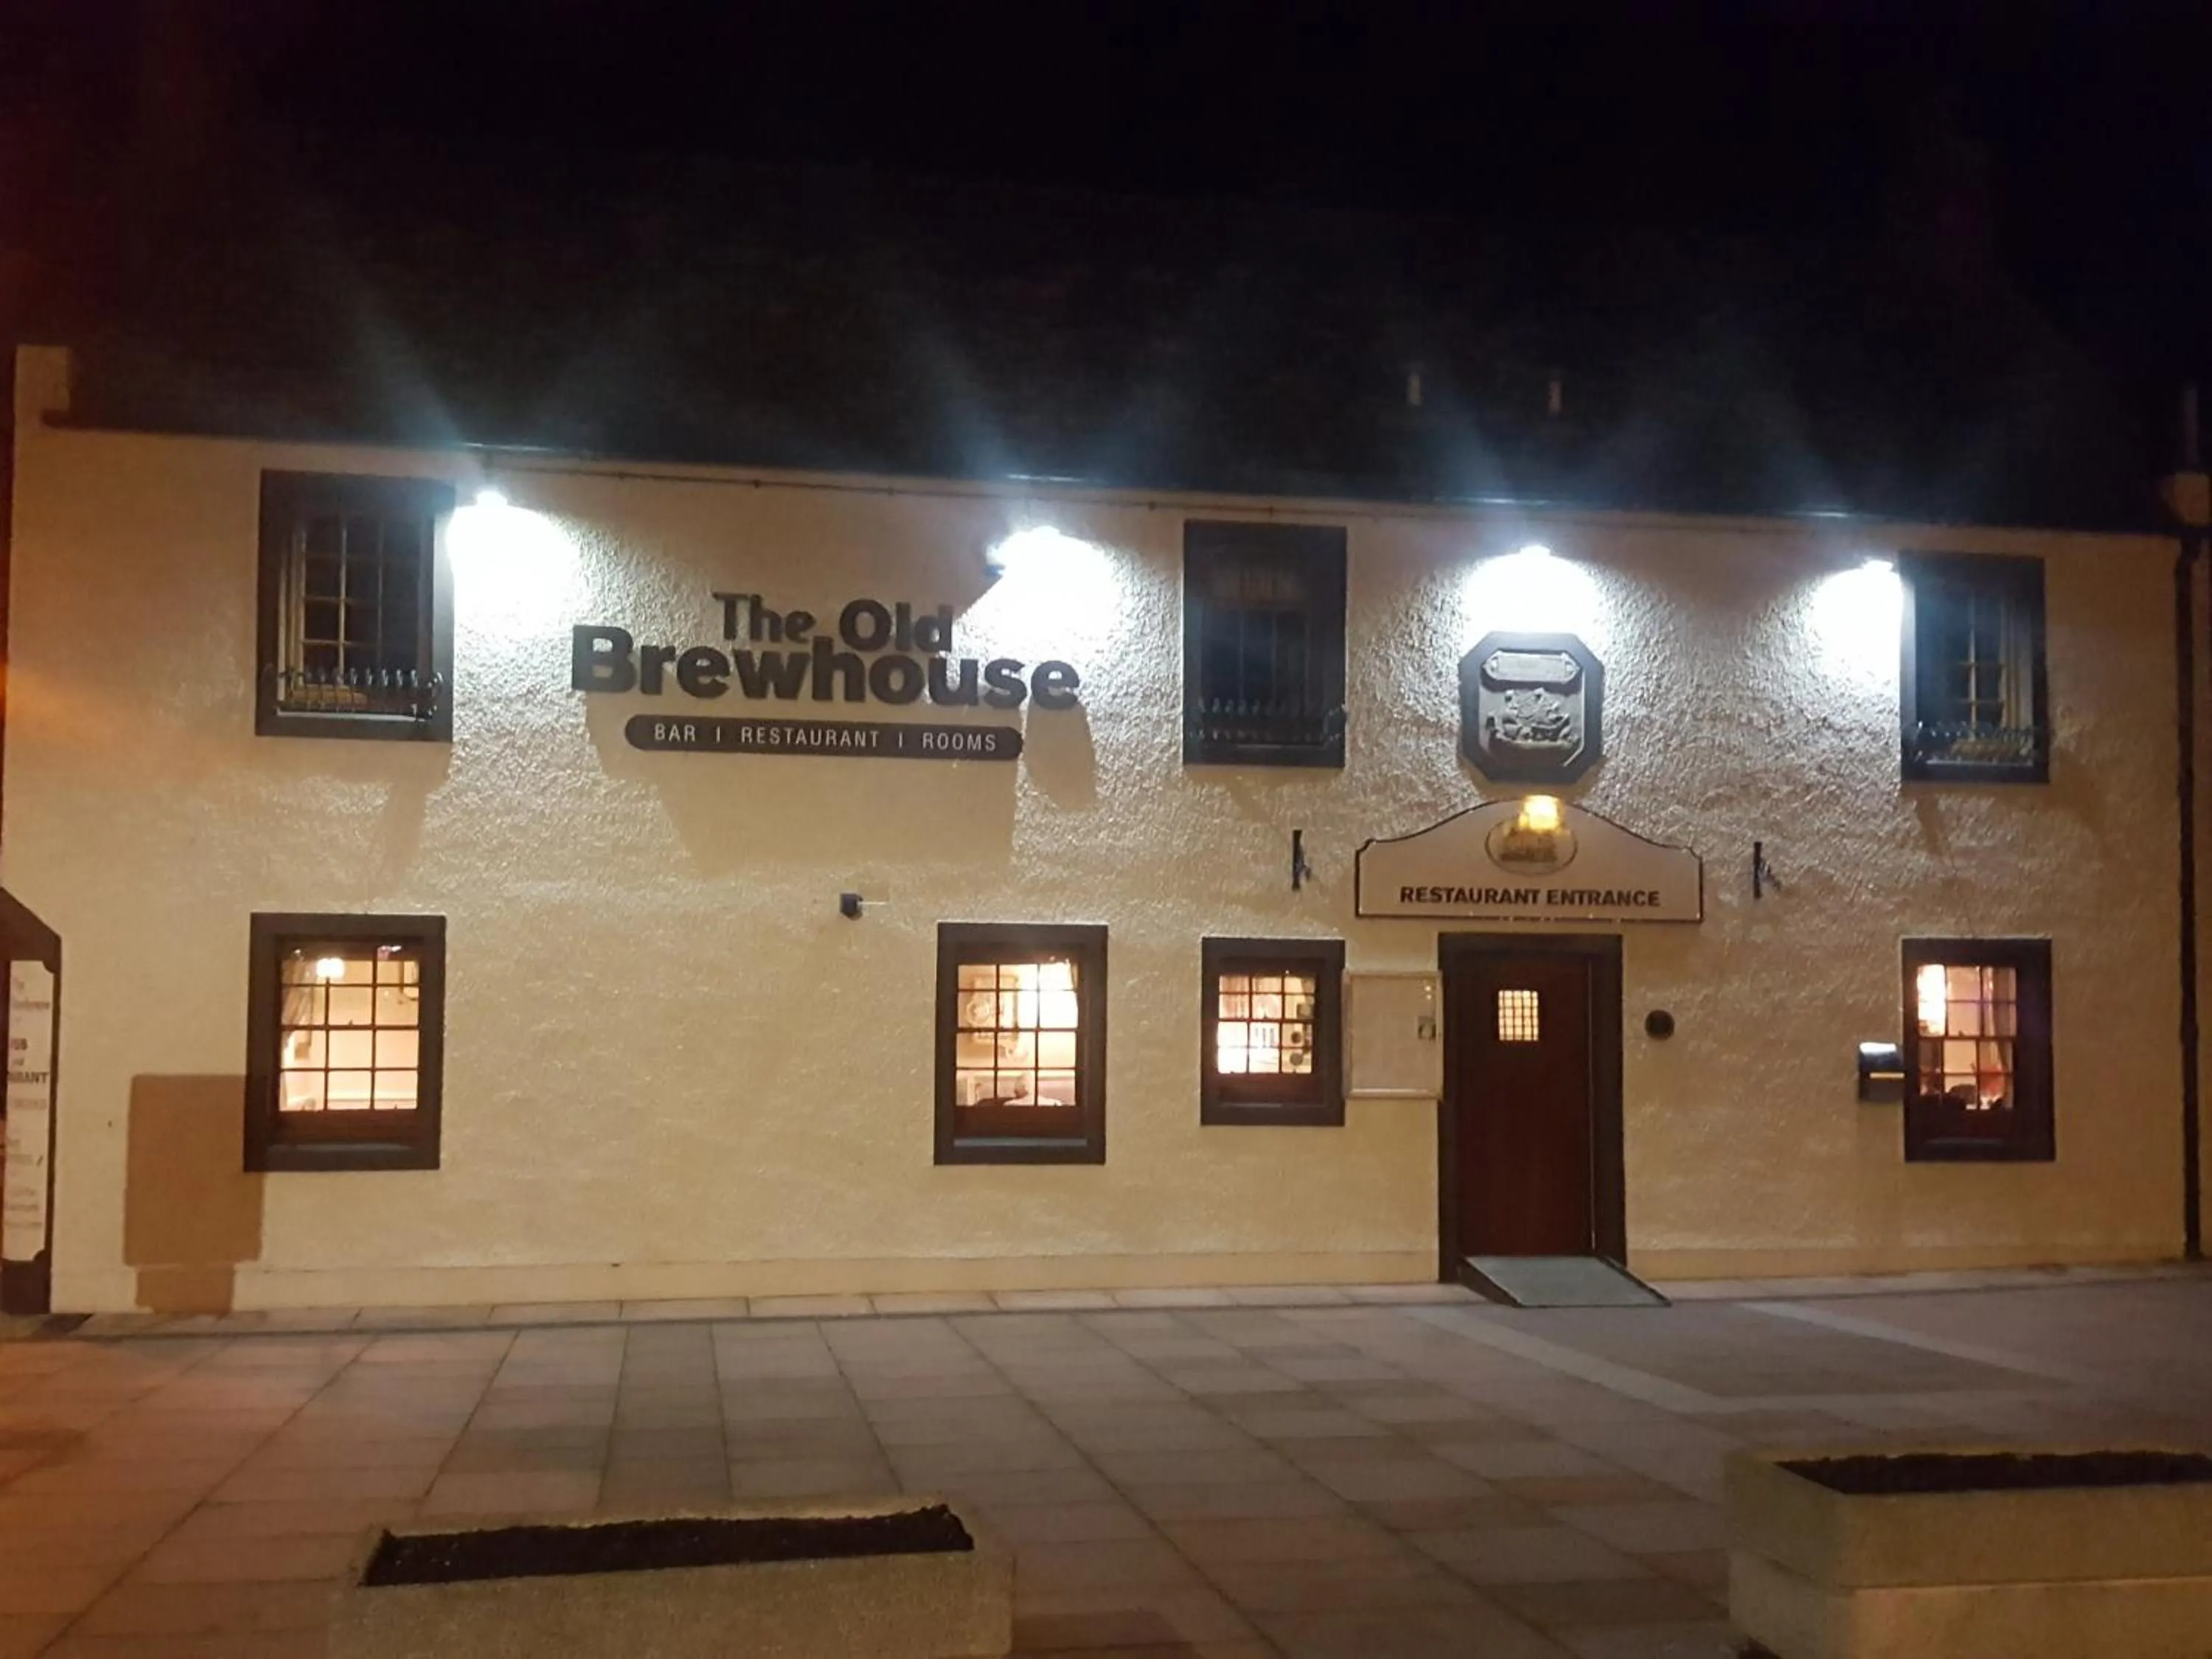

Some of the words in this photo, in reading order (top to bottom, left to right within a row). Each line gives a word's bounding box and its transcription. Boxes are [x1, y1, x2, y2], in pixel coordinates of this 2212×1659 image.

[713, 592, 816, 645] The
[840, 599, 953, 652] Old
[572, 625, 1080, 709] Brewhouse
[655, 723, 696, 742] BAR
[741, 727, 880, 748] RESTAURANT
[923, 733, 997, 751] ROOMS
[1401, 886, 1540, 905] RESTAURANT
[1546, 889, 1660, 907] ENTRANCE
